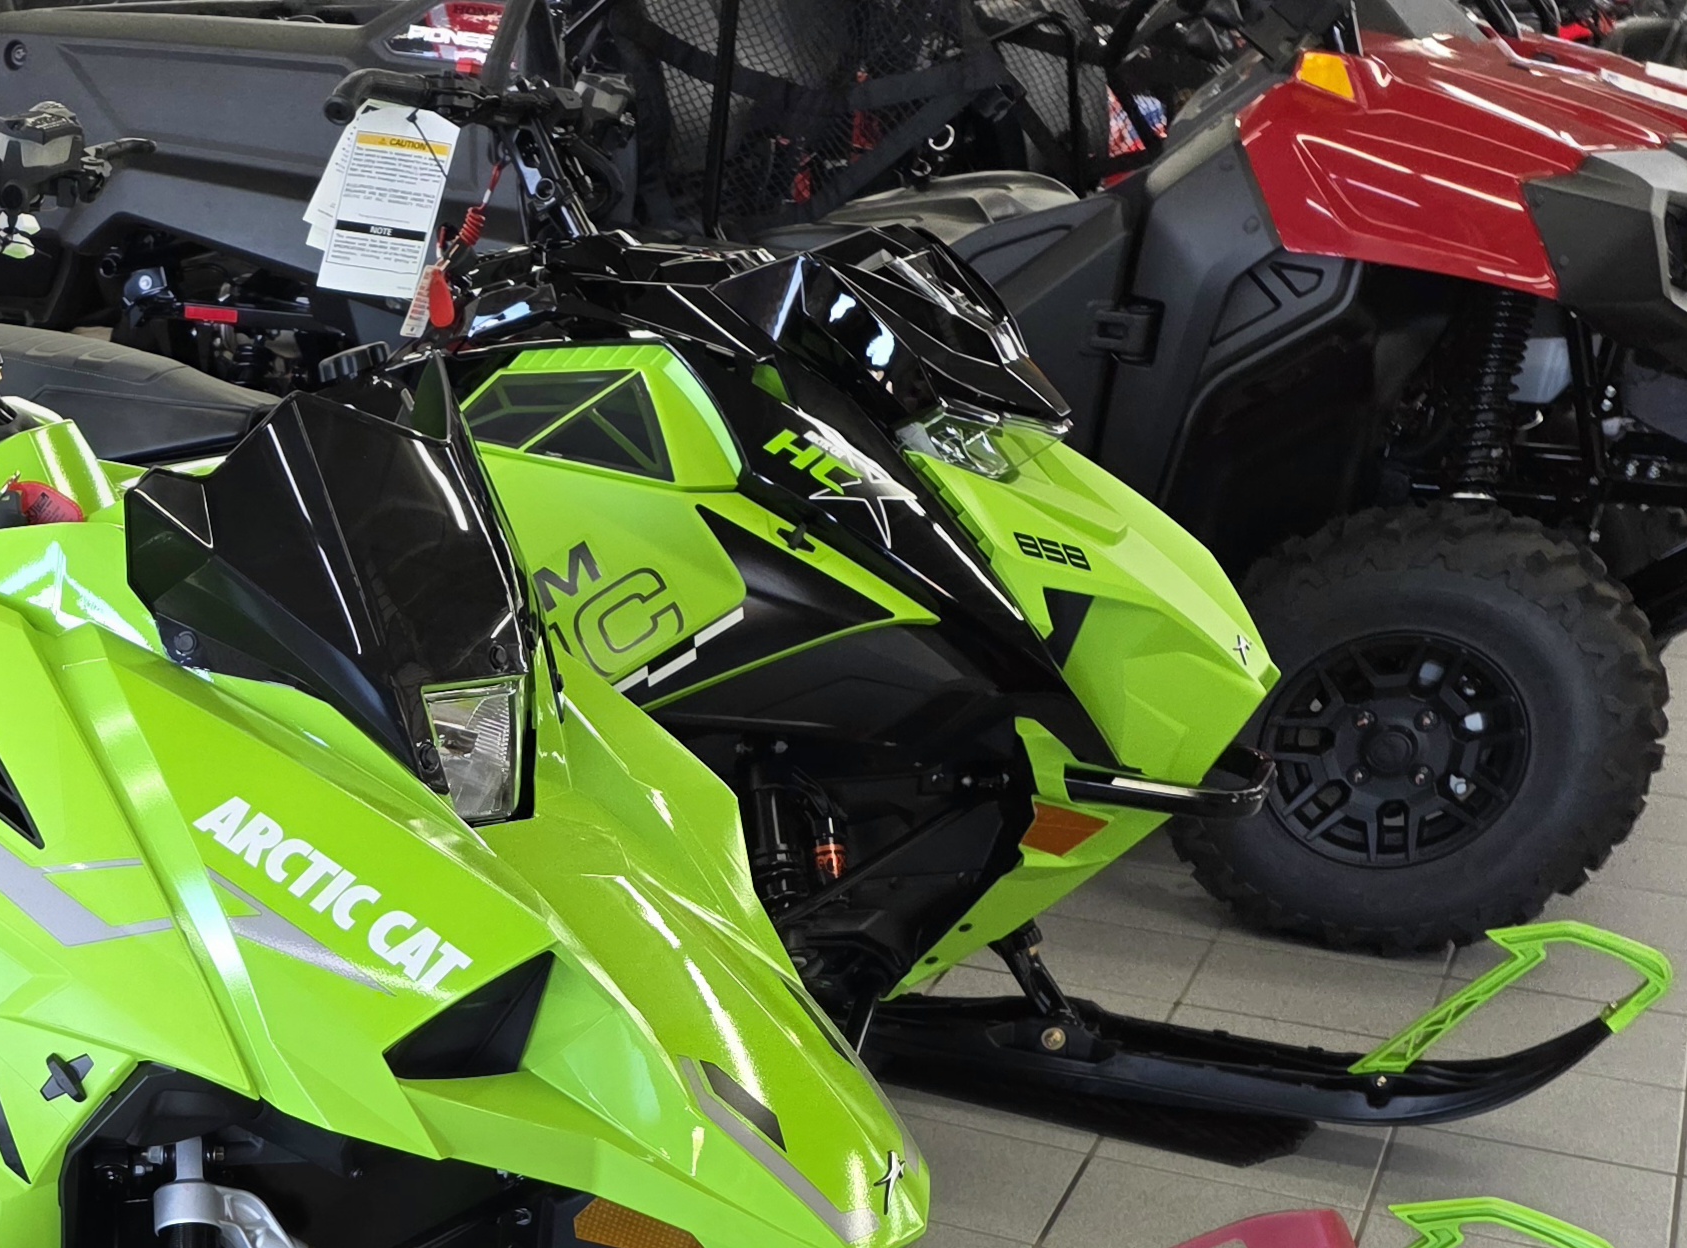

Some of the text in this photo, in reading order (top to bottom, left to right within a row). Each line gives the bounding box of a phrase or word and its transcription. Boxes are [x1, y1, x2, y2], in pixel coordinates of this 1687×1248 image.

[407, 24, 495, 49] PIONEE
[389, 138, 427, 150] CAUTION
[370, 226, 394, 236] NOTE
[1013, 531, 1092, 572] 858
[192, 796, 474, 990] ARCTIC CAT
